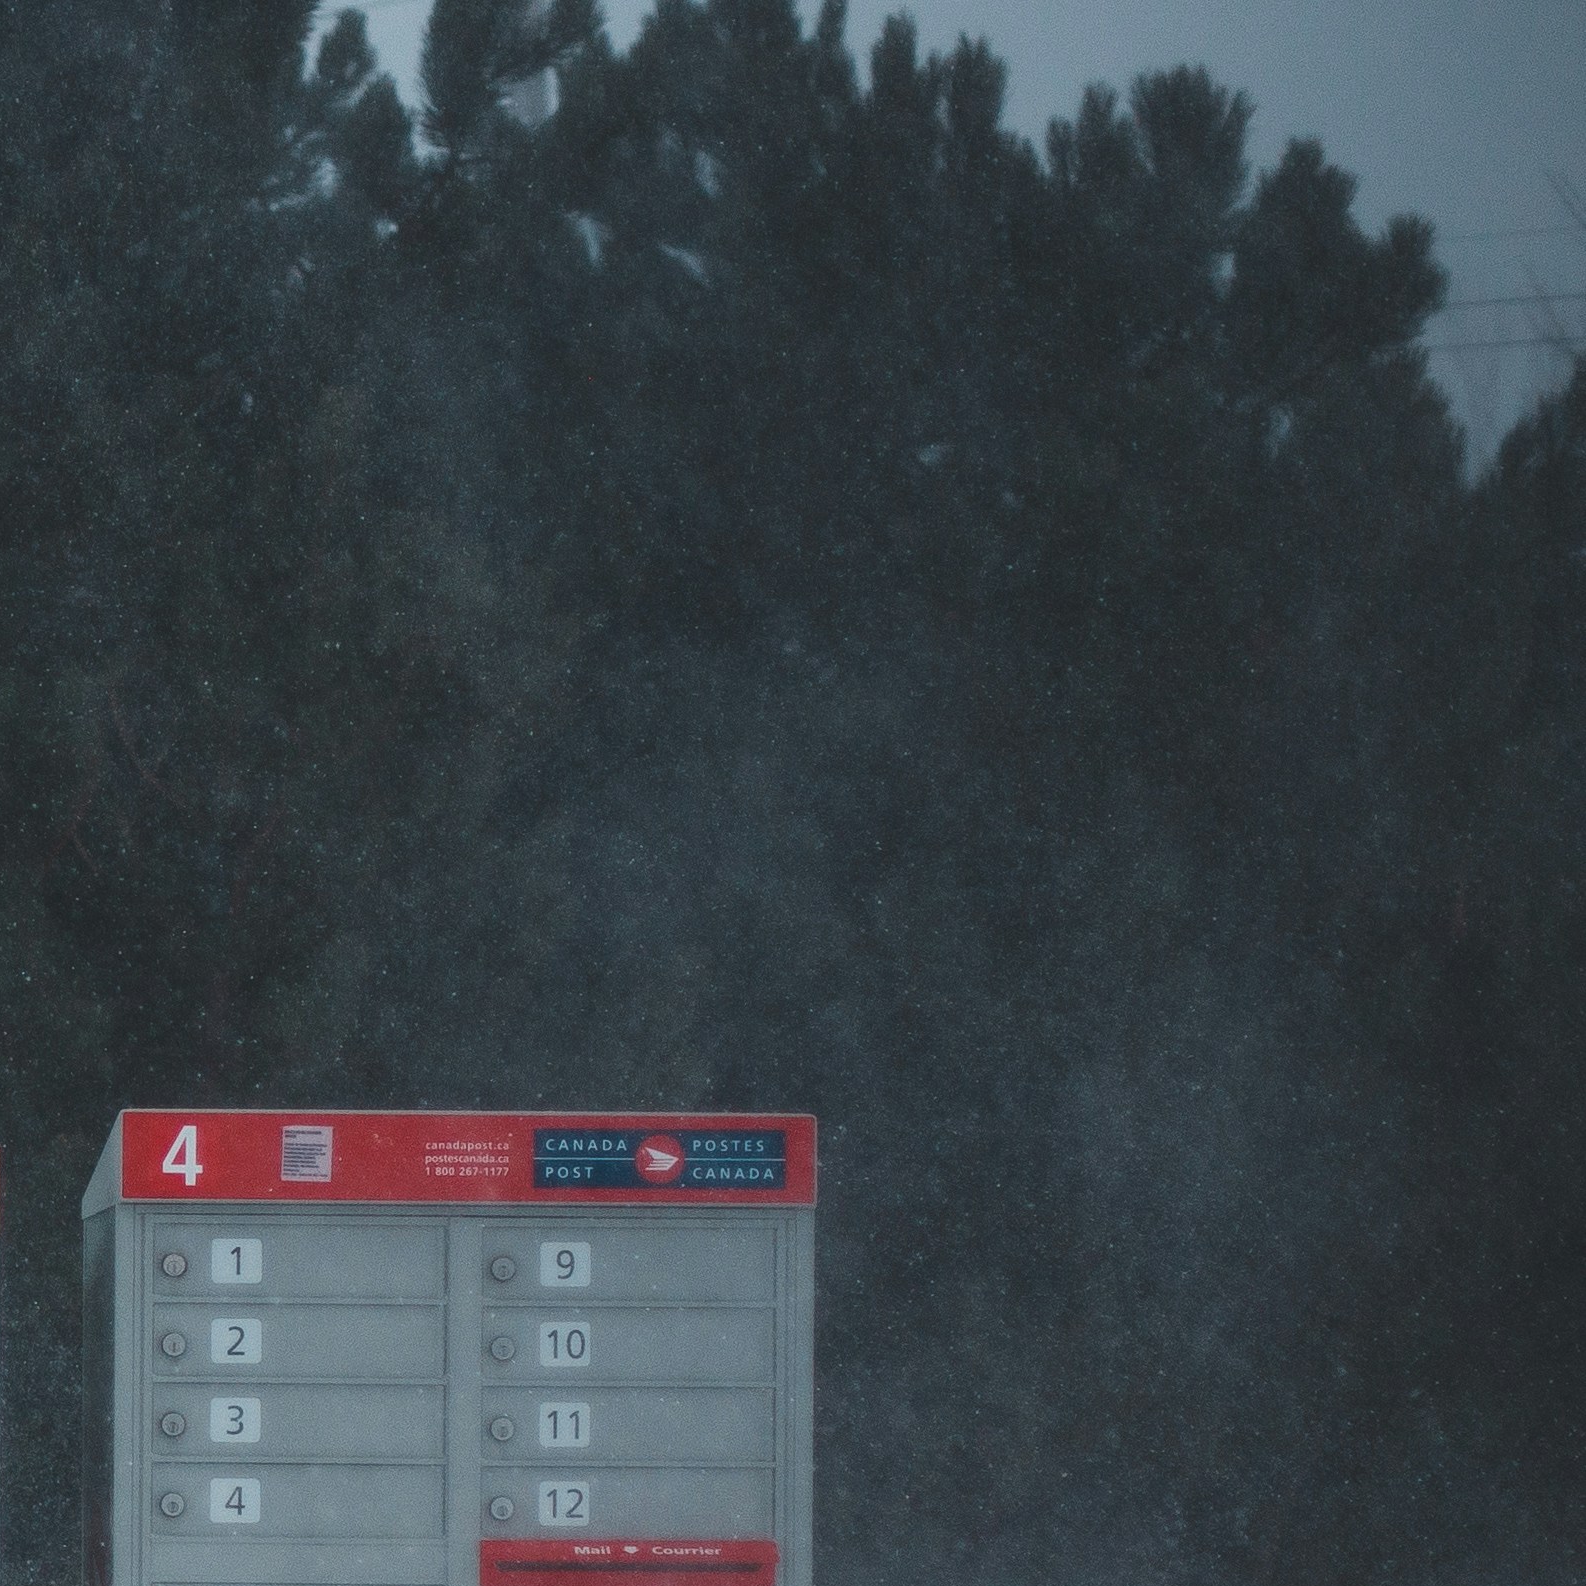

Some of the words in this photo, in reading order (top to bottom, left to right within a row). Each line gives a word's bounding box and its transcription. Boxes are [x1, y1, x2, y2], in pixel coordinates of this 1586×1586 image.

[162, 1125, 204, 1187] 4
[425, 1141, 509, 1152] canadapost.ca
[425, 1154, 509, 1165] postescanada.ca
[545, 1138, 627, 1151] CANADA
[692, 1140, 765, 1152] POSTES
[425, 1167, 430, 1176] 1
[435, 1167, 455, 1176] 800
[459, 1167, 509, 1176] 267-1177
[545, 1166, 594, 1179] POST
[692, 1167, 774, 1180] CANADA
[230, 1246, 242, 1276] 1
[556, 1249, 576, 1280] 9
[226, 1325, 246, 1356] 2
[547, 1329, 586, 1360] 10
[226, 1405, 245, 1436] 3
[547, 1410, 580, 1440] 11
[224, 1486, 246, 1516] 4
[546, 1488, 584, 1519] 12
[574, 1546, 611, 1554] Mail
[651, 1546, 722, 1555] Courrier
